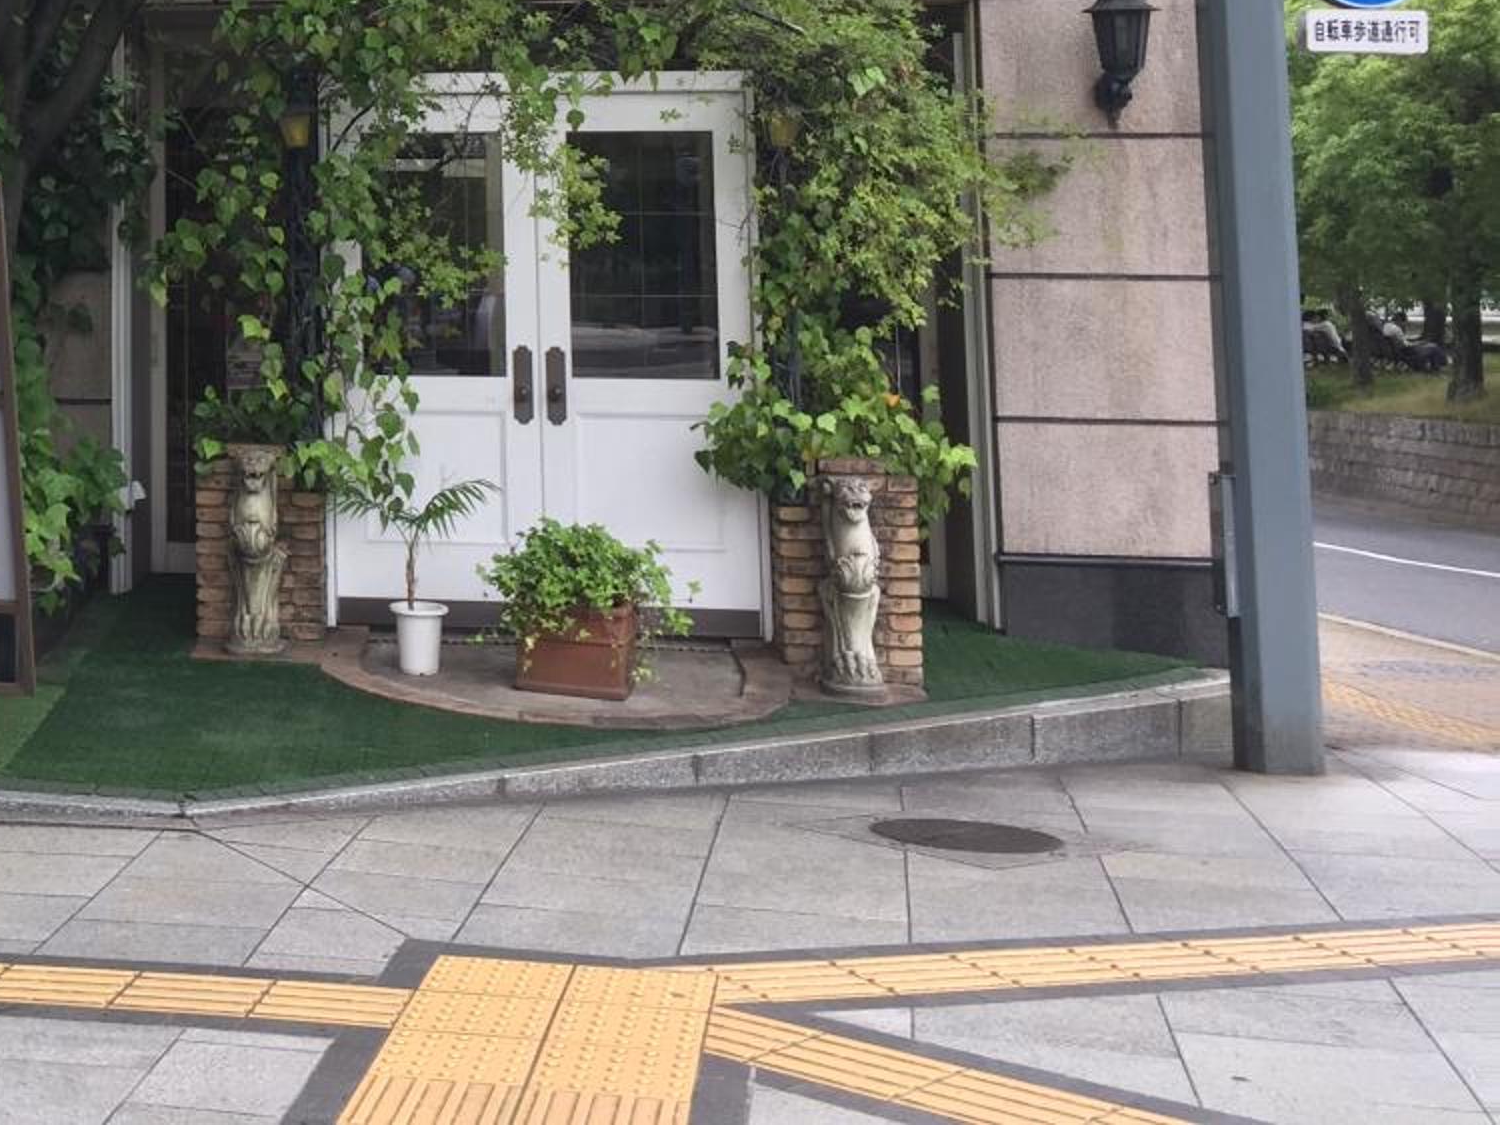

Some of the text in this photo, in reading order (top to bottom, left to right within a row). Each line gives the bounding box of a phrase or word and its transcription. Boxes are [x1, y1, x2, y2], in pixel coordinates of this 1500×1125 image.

[1314, 19, 1421, 44] 自転車歩道通行可
